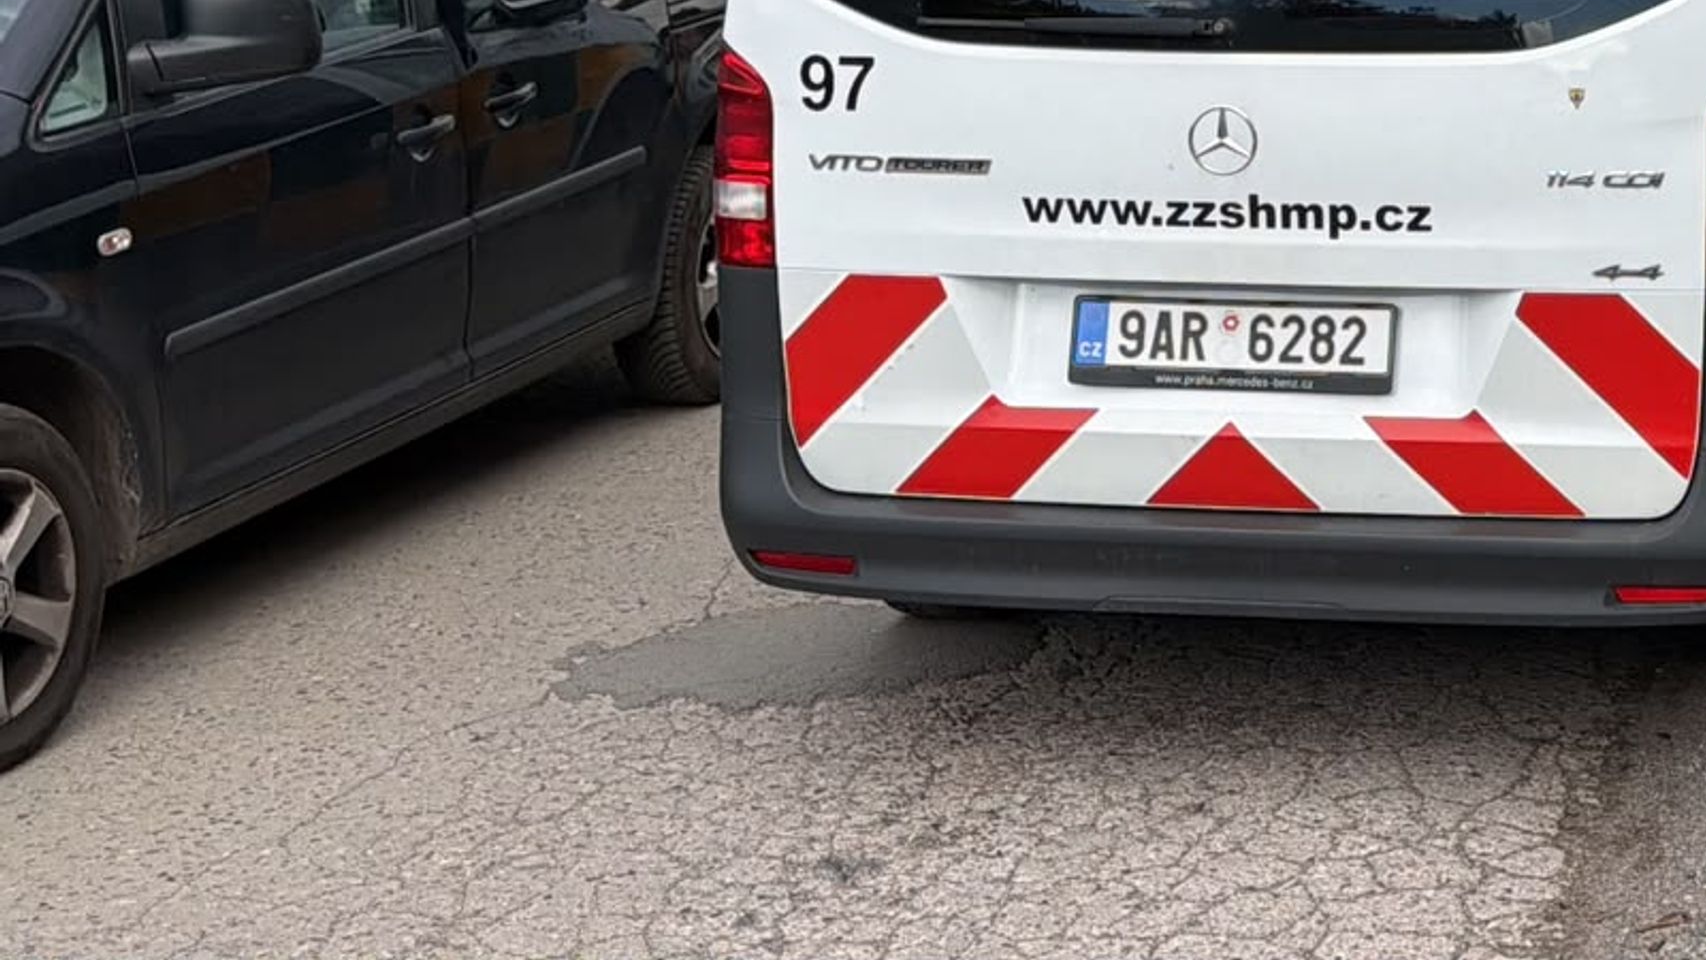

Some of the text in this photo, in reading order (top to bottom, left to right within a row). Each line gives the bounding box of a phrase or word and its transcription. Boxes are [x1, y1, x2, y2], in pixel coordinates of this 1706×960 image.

[800, 54, 875, 111] 97
[808, 153, 990, 174] VITO TOURER
[1547, 173, 1665, 188] 114 CDI
[1023, 194, 1432, 239] www.zzshmp.cz
[1079, 309, 1367, 366] CZ 9AR 6282
[1154, 374, 1314, 390] www.praha.mercedes-benz.cz
